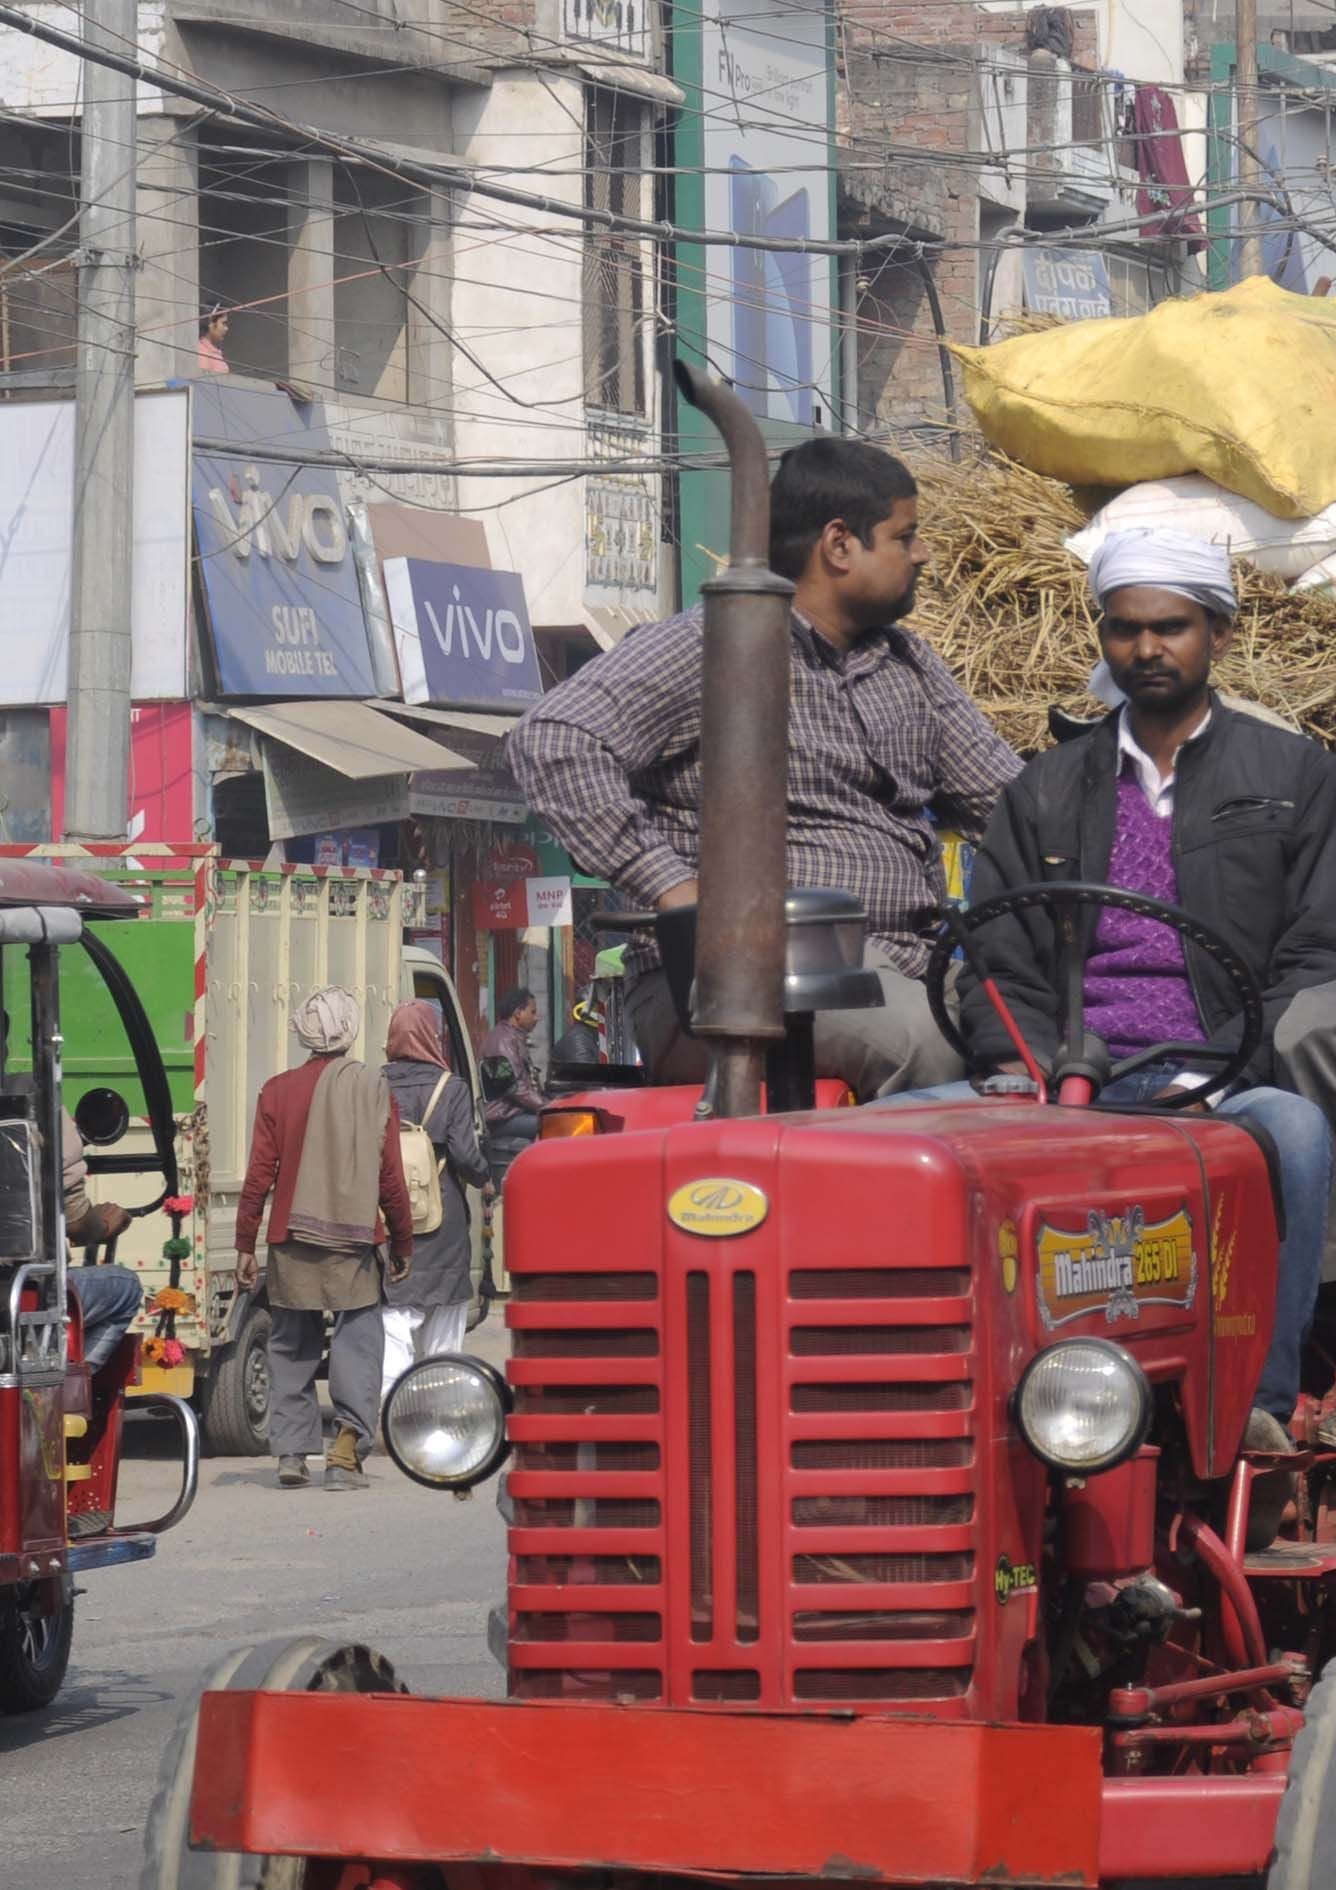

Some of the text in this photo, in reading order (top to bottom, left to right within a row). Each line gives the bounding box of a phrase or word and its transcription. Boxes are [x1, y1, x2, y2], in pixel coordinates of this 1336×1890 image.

[1034, 246, 1097, 293] दीपक
[208, 464, 347, 563] vivo
[271, 604, 319, 646] SUFI
[423, 583, 525, 664] vivo
[264, 648, 315, 675] MOBILE
[535, 889, 564, 901] MNP
[1054, 1239, 1178, 1297] Mahindra 265 DI
